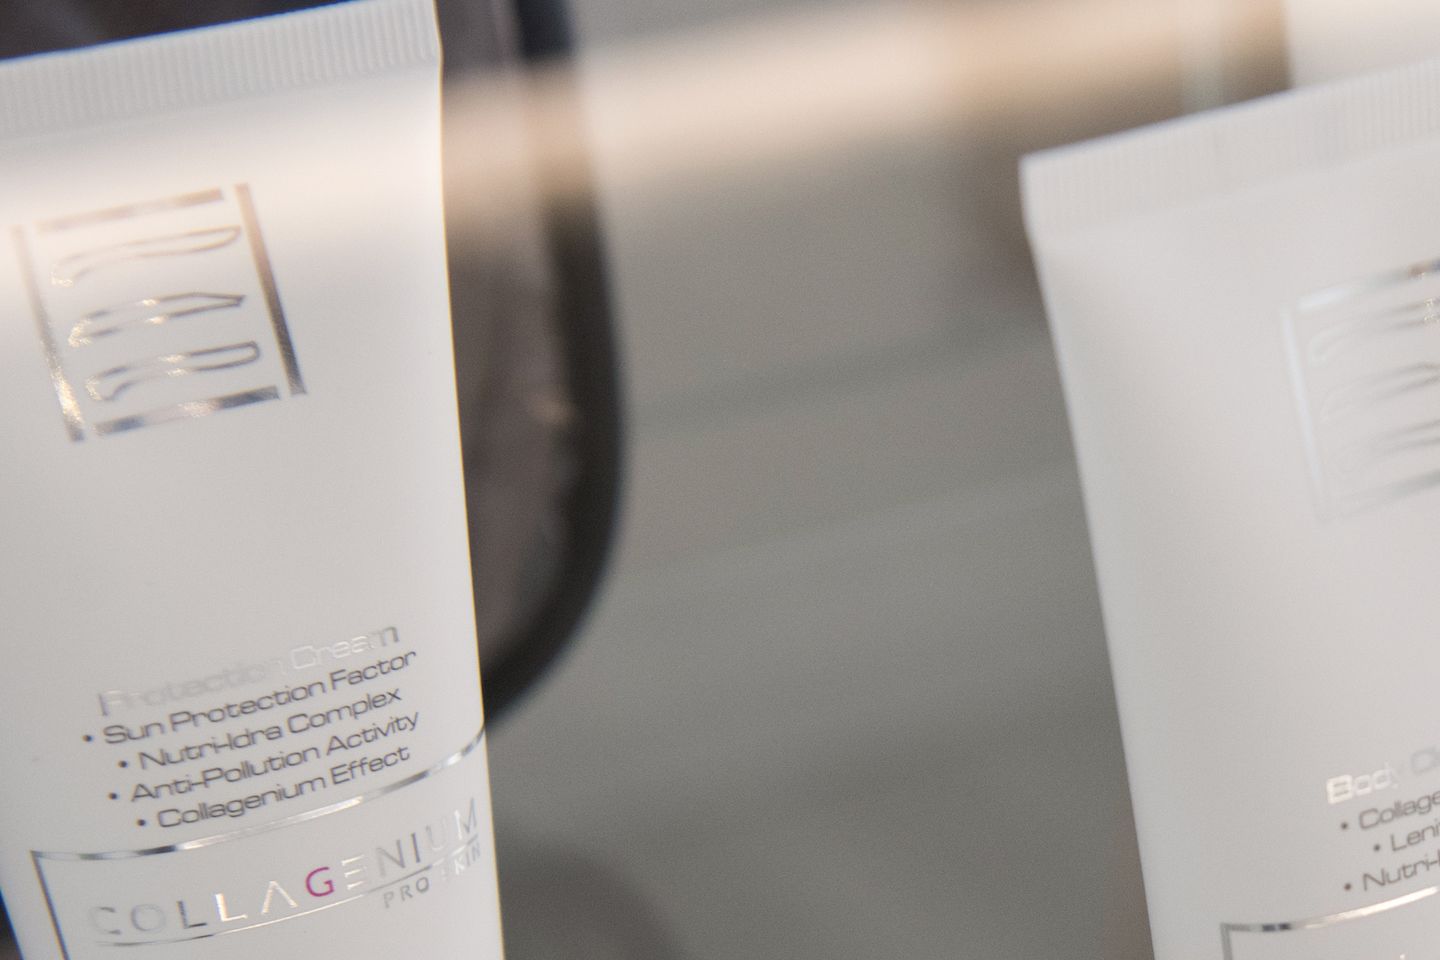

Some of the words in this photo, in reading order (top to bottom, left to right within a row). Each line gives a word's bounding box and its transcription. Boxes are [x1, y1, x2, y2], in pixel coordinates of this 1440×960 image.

[290, 624, 401, 670] Cream
[103, 719, 165, 745] Sun
[170, 678, 327, 732] Protection
[329, 651, 417, 691] Factor
[138, 723, 284, 770] Nutri-Idra
[287, 688, 402, 735] Complex
[131, 746, 320, 802] Anti-Pollution
[326, 712, 419, 757] Activity
[157, 776, 327, 829] Collagenium
[330, 746, 411, 787] Effect
[90, 797, 478, 935] COLLAGENIUM
[383, 876, 429, 909] PRO
